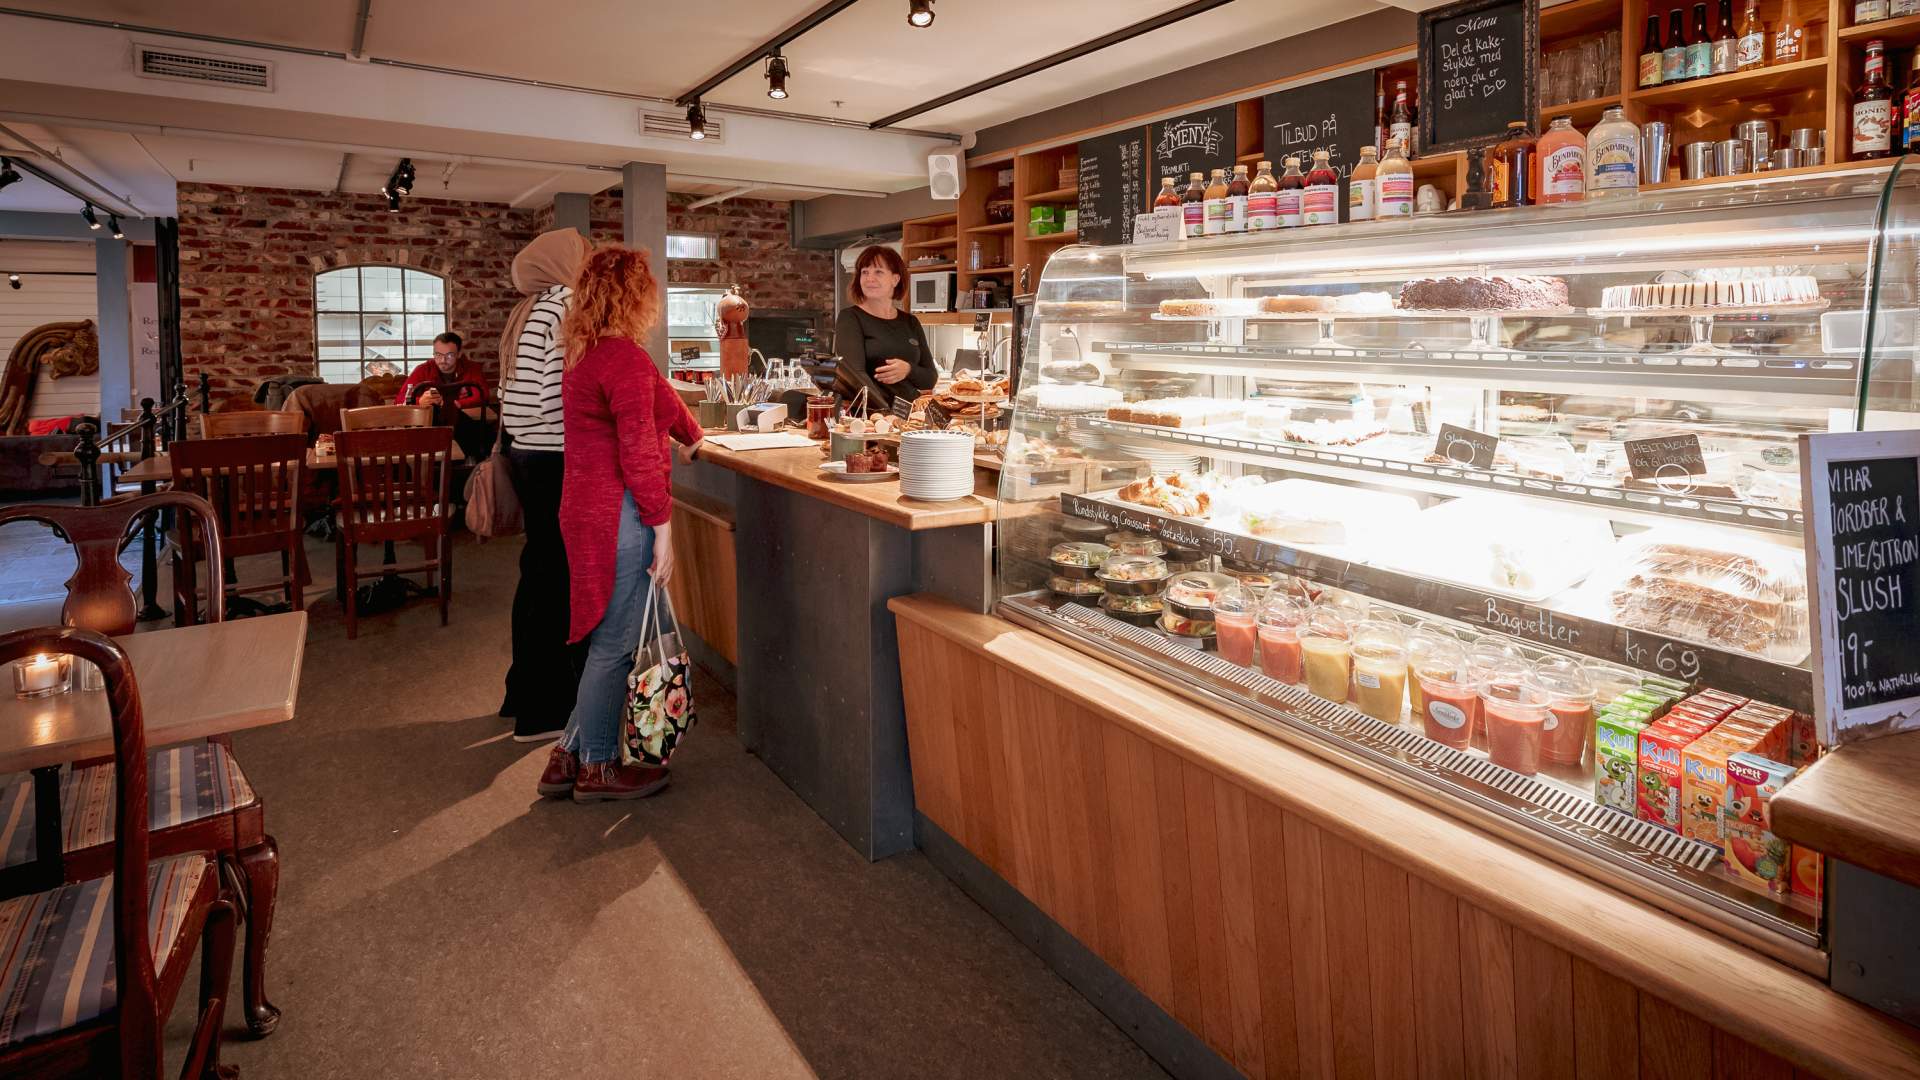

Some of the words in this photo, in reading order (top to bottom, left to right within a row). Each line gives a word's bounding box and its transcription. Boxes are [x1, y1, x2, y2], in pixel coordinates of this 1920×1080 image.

[1456, 16, 1499, 35] Menu
[1441, 42, 1460, 59] Del
[1462, 38, 1473, 55] et
[1712, 45, 1729, 64] IPA
[1442, 55, 1476, 78] stykke
[1480, 47, 1502, 64] med
[1443, 75, 1470, 88] noen
[1471, 67, 1487, 84] du
[1489, 67, 1500, 78] er
[1444, 85, 1467, 110] glad
[1469, 83, 1475, 97] i
[1169, 126, 1208, 149] MENY
[1273, 122, 1319, 145] TILBUD
[1322, 113, 1338, 139] PÅ
[1844, 466, 1873, 493] HAR
[1895, 495, 1907, 523] &
[1837, 574, 1903, 621] SLUSH
[1484, 597, 1580, 643] Baguetter
[1625, 630, 1647, 664] kr
[1656, 643, 1701, 678] 69
[1845, 680, 1877, 699] 100%
[1284, 708, 1398, 756] SMOOTHIE
[1599, 725, 1635, 753] Kuli
[1641, 738, 1680, 766] Kuli
[1684, 758, 1727, 785] Kuli
[1728, 761, 1762, 780] Sprett
[1520, 806, 1618, 847] JUICE
